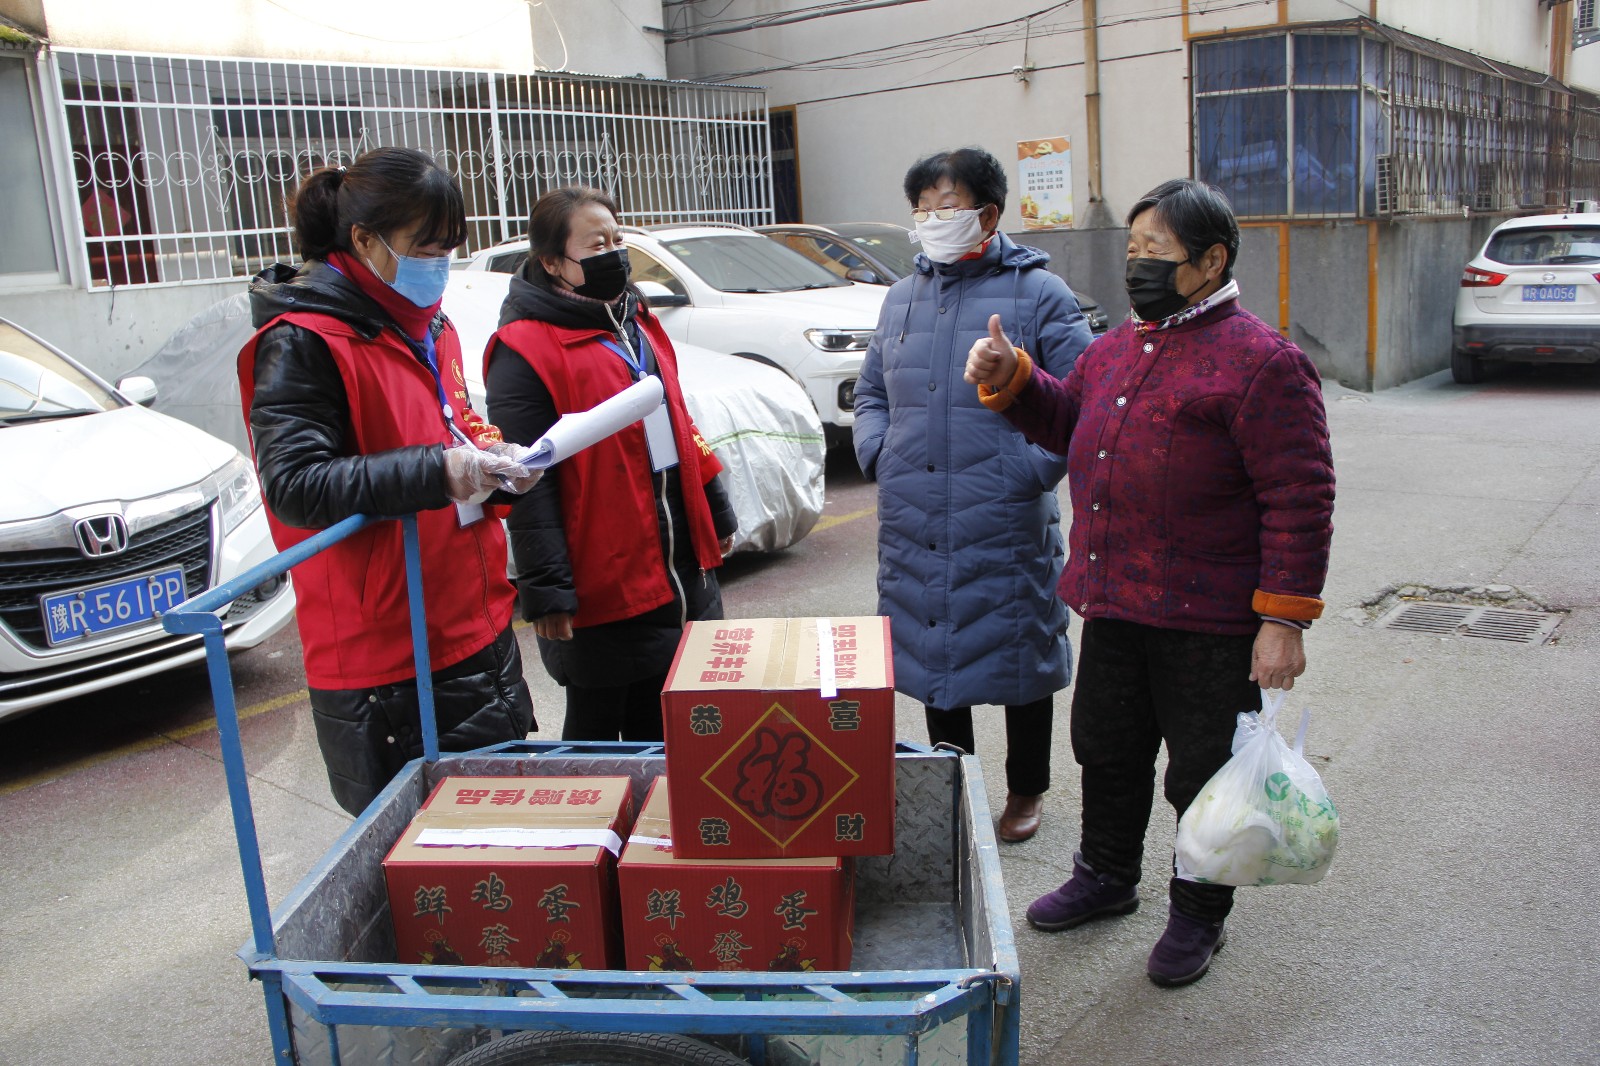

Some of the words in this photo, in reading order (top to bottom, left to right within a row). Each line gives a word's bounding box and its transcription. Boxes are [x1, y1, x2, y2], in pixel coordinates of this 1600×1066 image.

[700, 627, 756, 683] 营养丰富
[690, 704, 722, 736] 恭
[828, 700, 861, 731] 喜
[732, 726, 824, 821] 福
[455, 788, 603, 806] 馈赠佳品
[835, 813, 865, 841] 財
[413, 872, 581, 926] 鲜鸡蛋
[644, 876, 818, 930] 鲜鸡蛋
